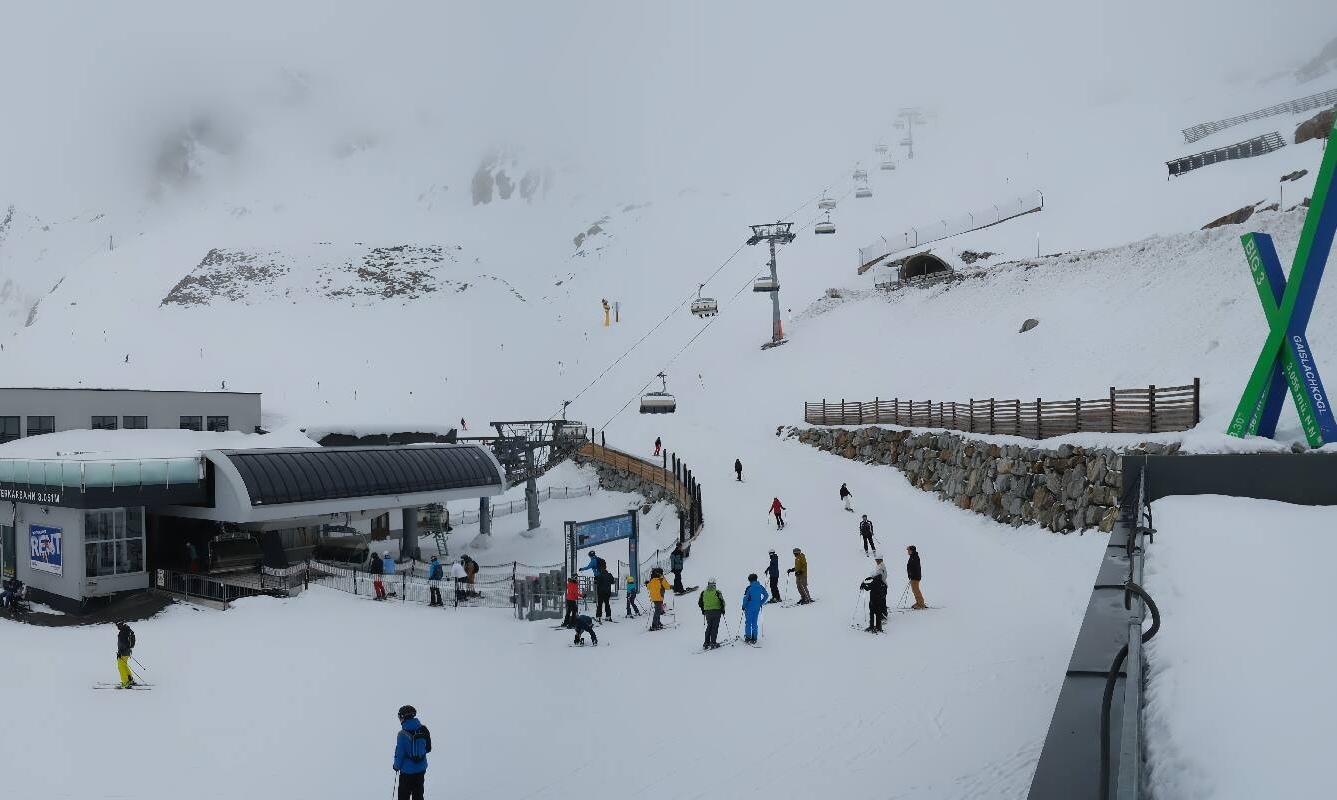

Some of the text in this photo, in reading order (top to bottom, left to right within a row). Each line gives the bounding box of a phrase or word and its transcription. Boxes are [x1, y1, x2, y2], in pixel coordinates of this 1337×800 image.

[1246, 238, 1265, 286] BIG 3
[1293, 335, 1327, 416] GAISLACHKOGL
